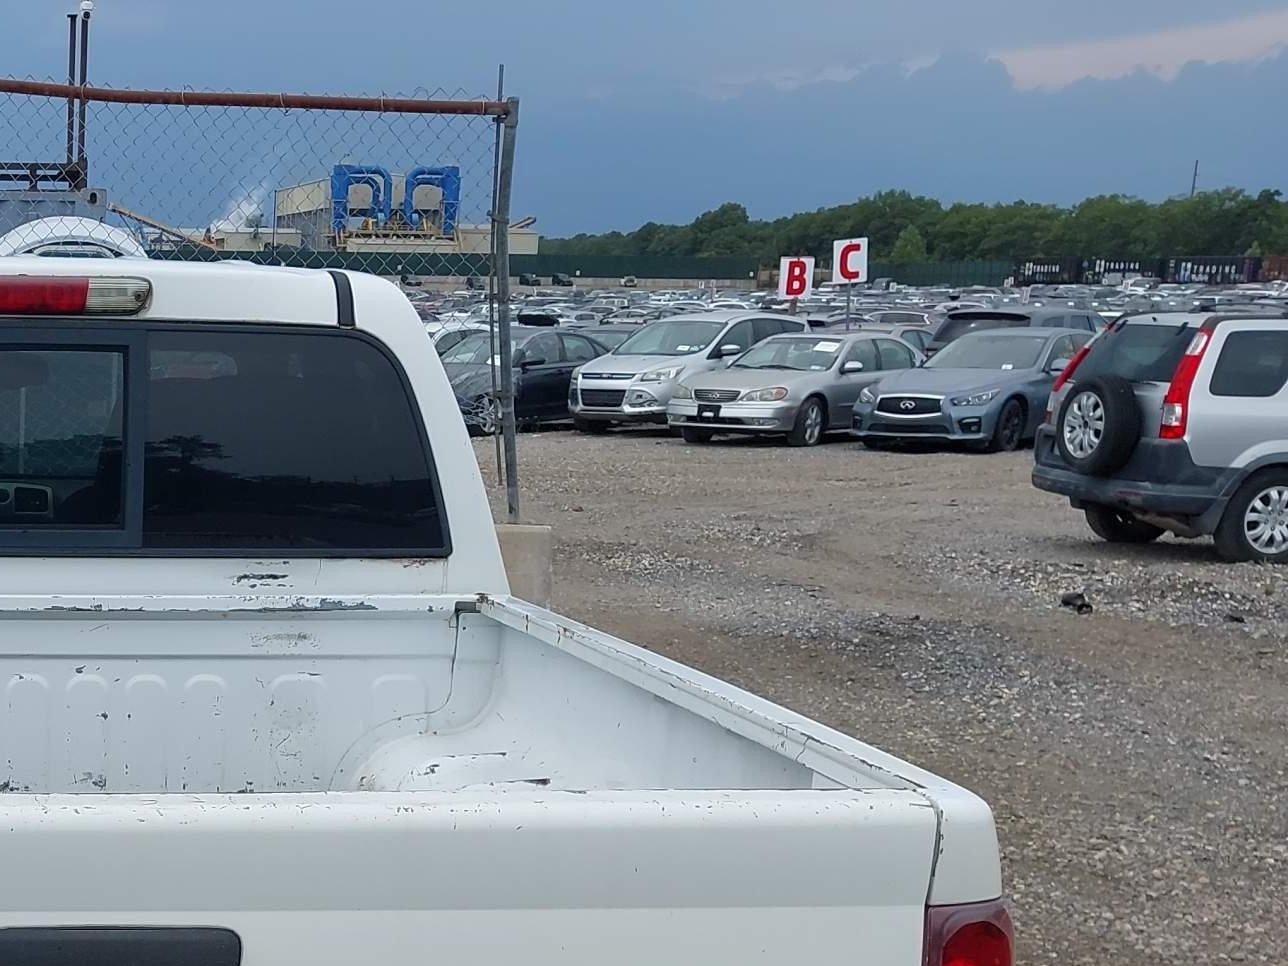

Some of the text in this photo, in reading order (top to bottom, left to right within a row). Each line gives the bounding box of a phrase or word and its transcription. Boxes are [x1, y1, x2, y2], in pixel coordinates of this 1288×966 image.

[786, 261, 807, 295] B
[840, 244, 861, 280] C
[1193, 264, 1237, 274] TRADING
